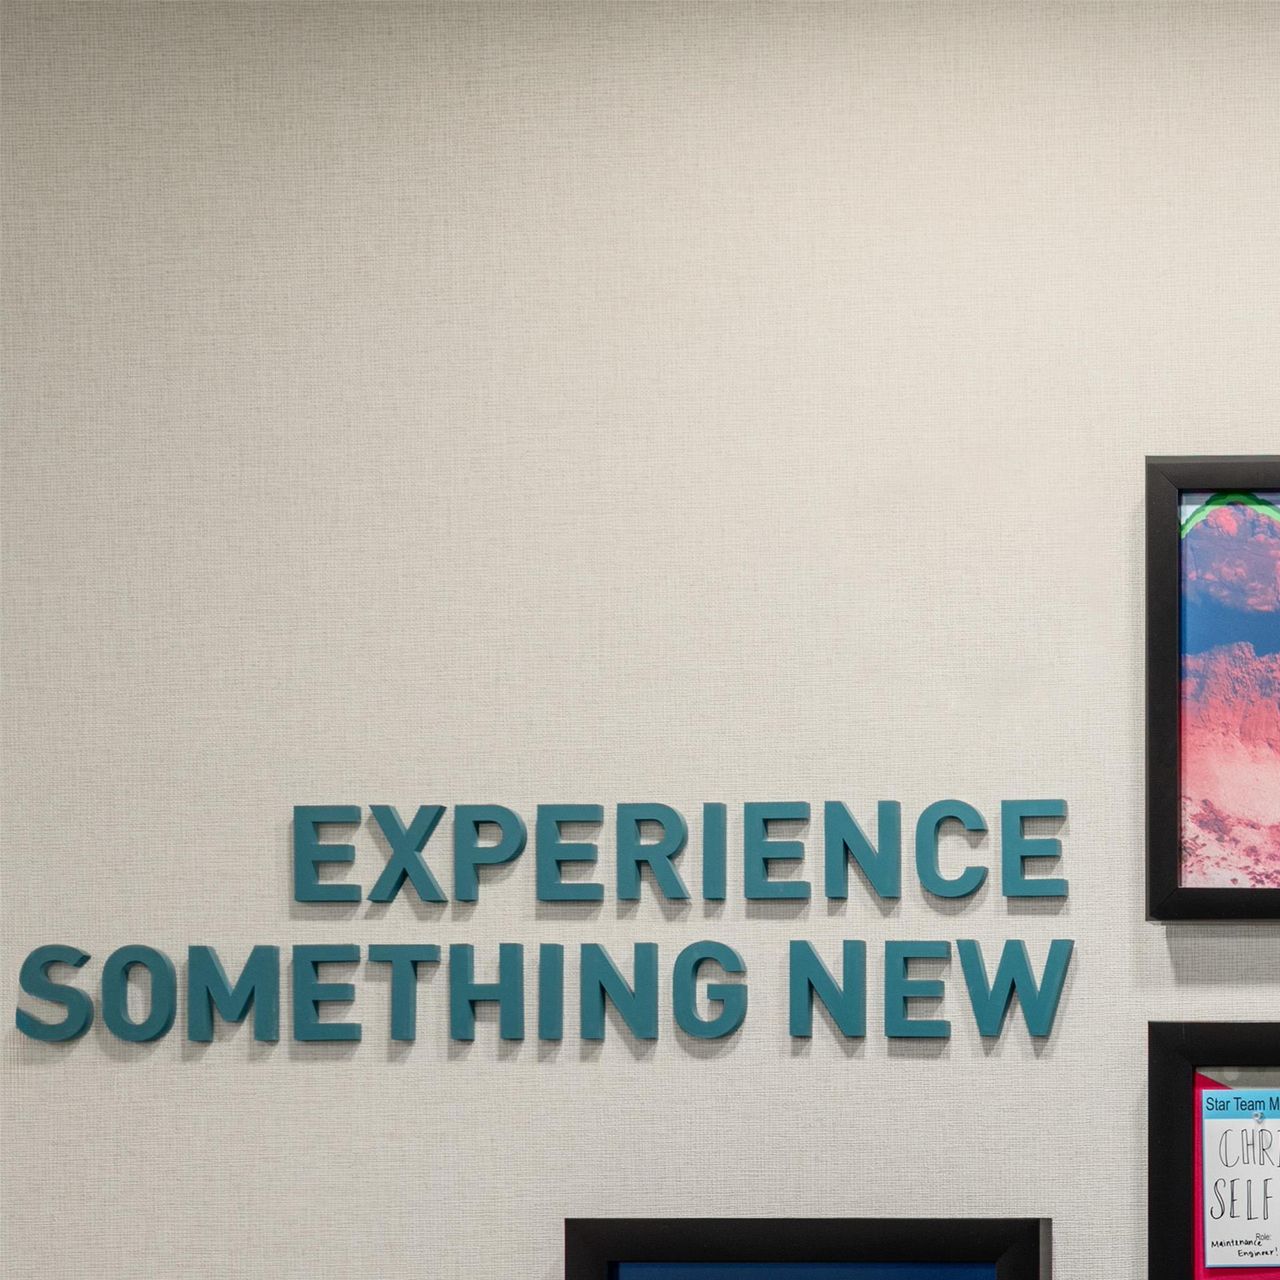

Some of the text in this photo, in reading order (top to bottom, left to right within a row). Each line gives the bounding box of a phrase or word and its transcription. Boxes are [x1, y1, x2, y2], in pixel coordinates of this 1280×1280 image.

[293, 799, 1070, 904] EXPERIENCE
[14, 938, 1076, 1043] SOMETHING NEW
[1206, 1097, 1230, 1111] Star
[1234, 1097, 1266, 1111] Team
[1210, 1178, 1273, 1221] SELF
